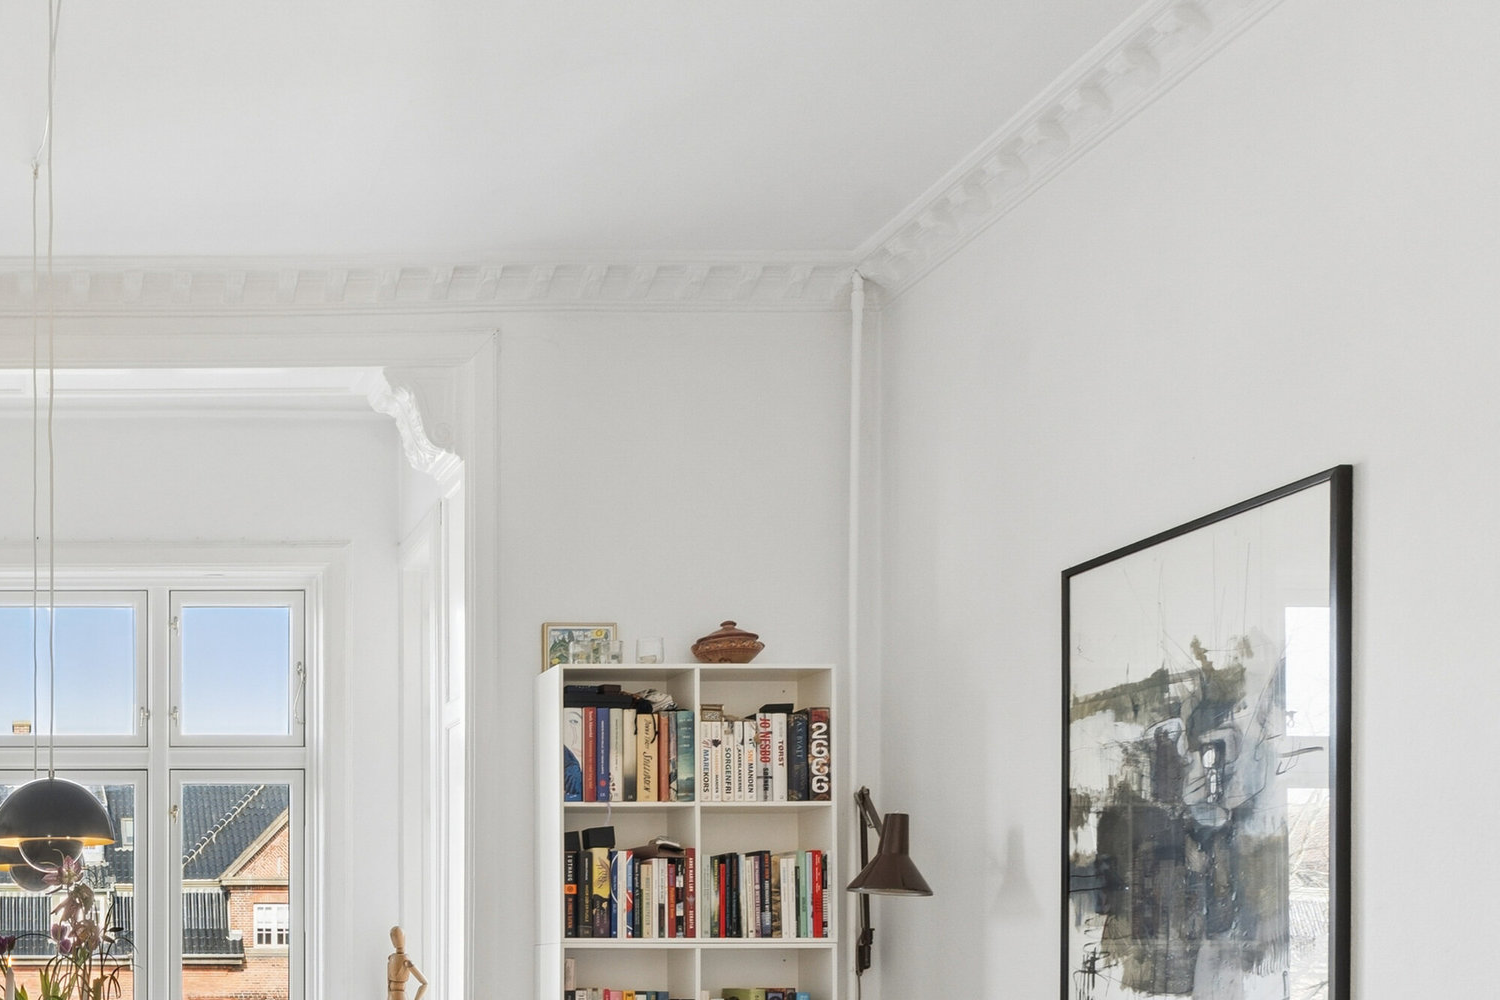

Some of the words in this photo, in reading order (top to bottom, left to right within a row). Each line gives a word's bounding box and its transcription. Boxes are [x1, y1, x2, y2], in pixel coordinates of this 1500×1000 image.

[760, 717, 770, 728] JO
[760, 732, 770, 763] NESBØ
[812, 722, 829, 793] 2666
